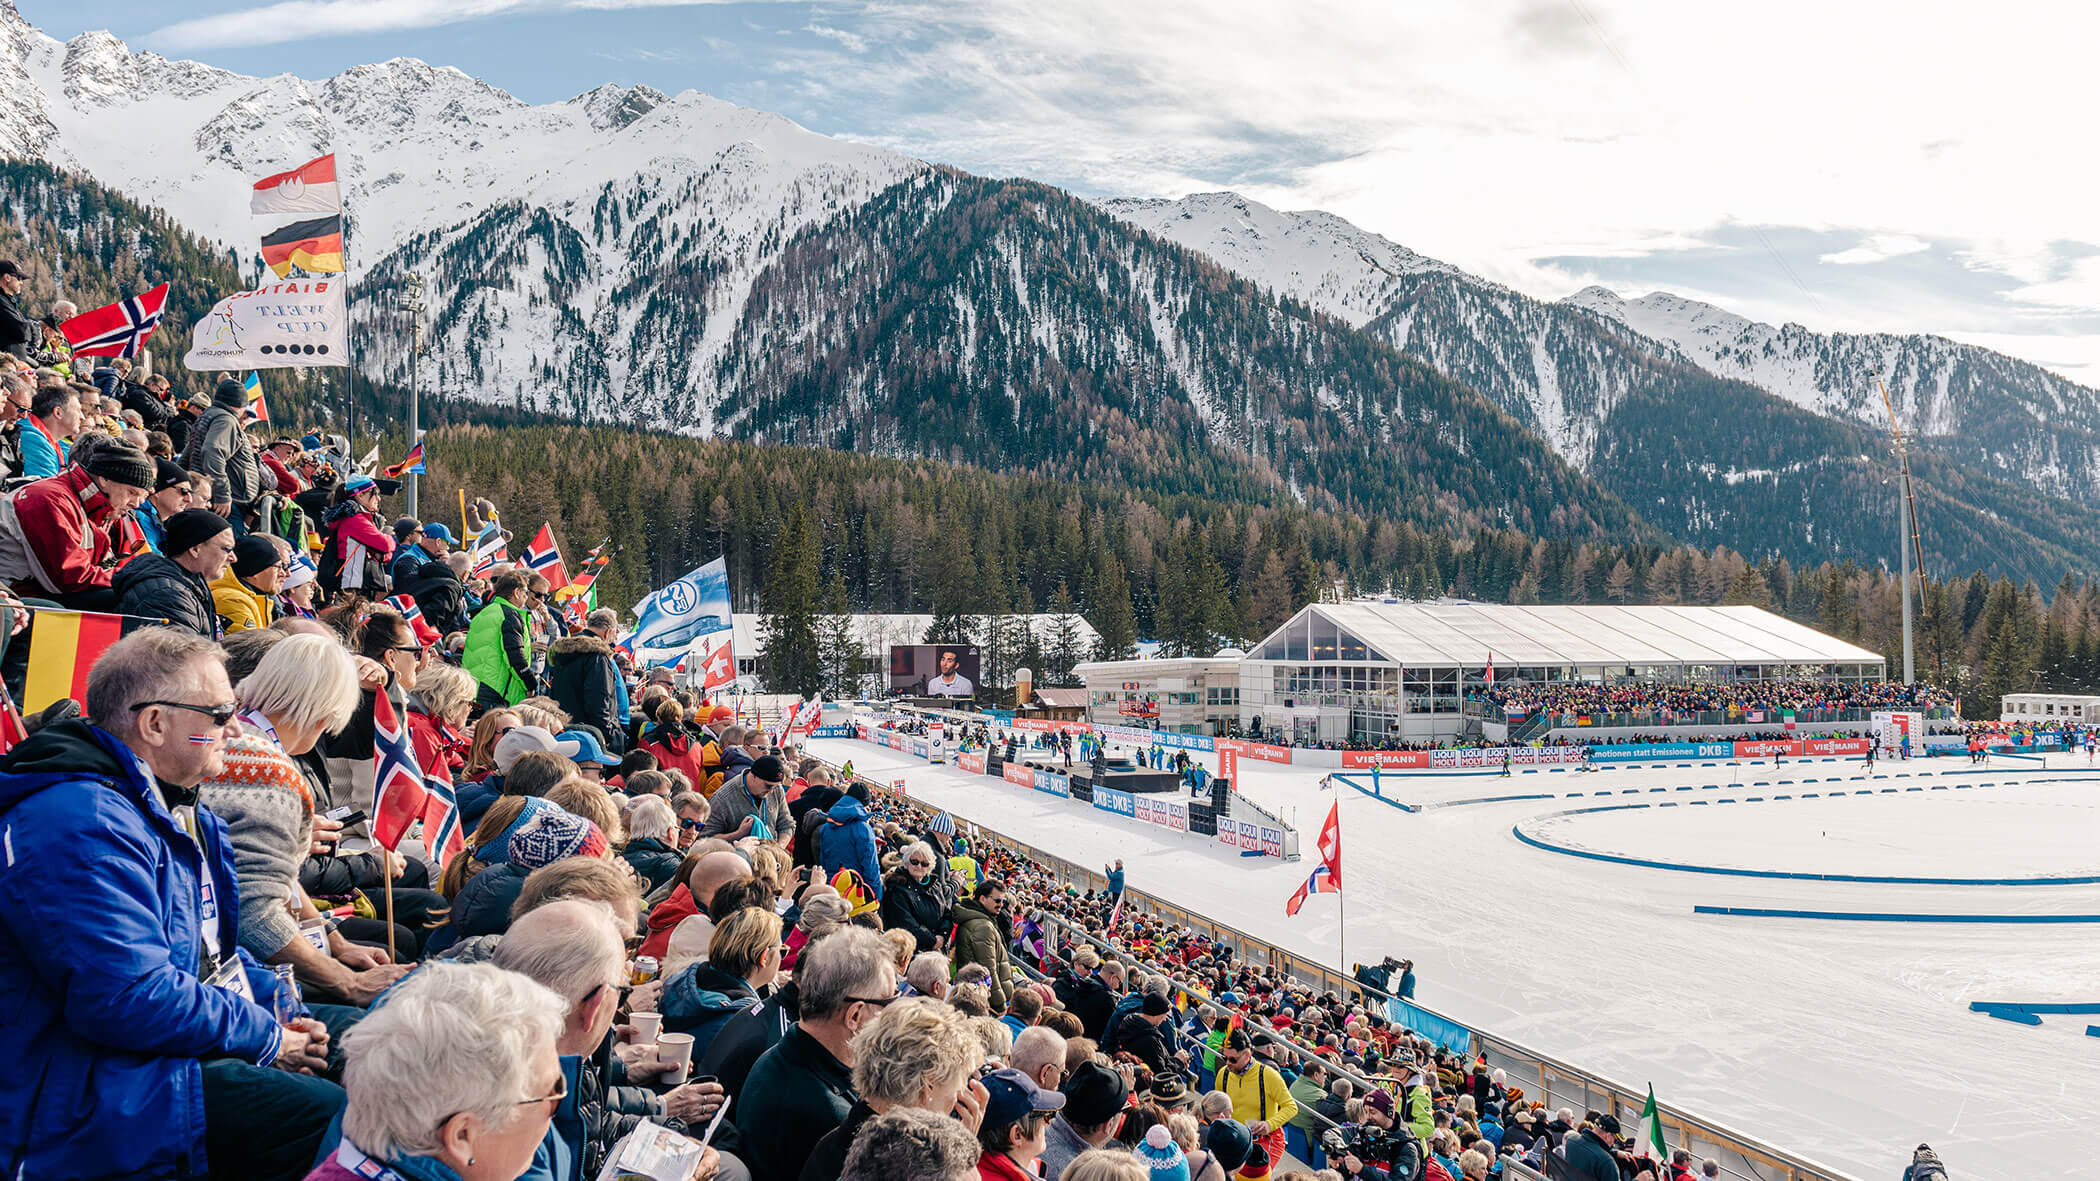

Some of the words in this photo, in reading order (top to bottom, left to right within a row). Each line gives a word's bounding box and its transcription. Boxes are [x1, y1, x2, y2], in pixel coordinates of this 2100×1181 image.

[1434, 751, 1455, 759] LIQUI
[1462, 749, 1482, 758] LIQUI
[1514, 748, 1533, 756] LIQUI
[1539, 747, 1560, 755] LIQUI
[1593, 749, 1631, 758] motionen
[1633, 748, 1650, 757] statt
[1652, 747, 1694, 756] Emissionen
[1699, 745, 1722, 757] DKB
[1434, 759, 1456, 767] MOLY
[1462, 758, 1482, 766] MOLY
[1513, 756, 1533, 764] MOLY
[1539, 755, 1560, 763] MOLY
[1219, 830, 1236, 845] MOLY
[1262, 828, 1280, 844] LIQUI
[1240, 835, 1257, 850] MOLY
[1262, 841, 1280, 857] MOLY
